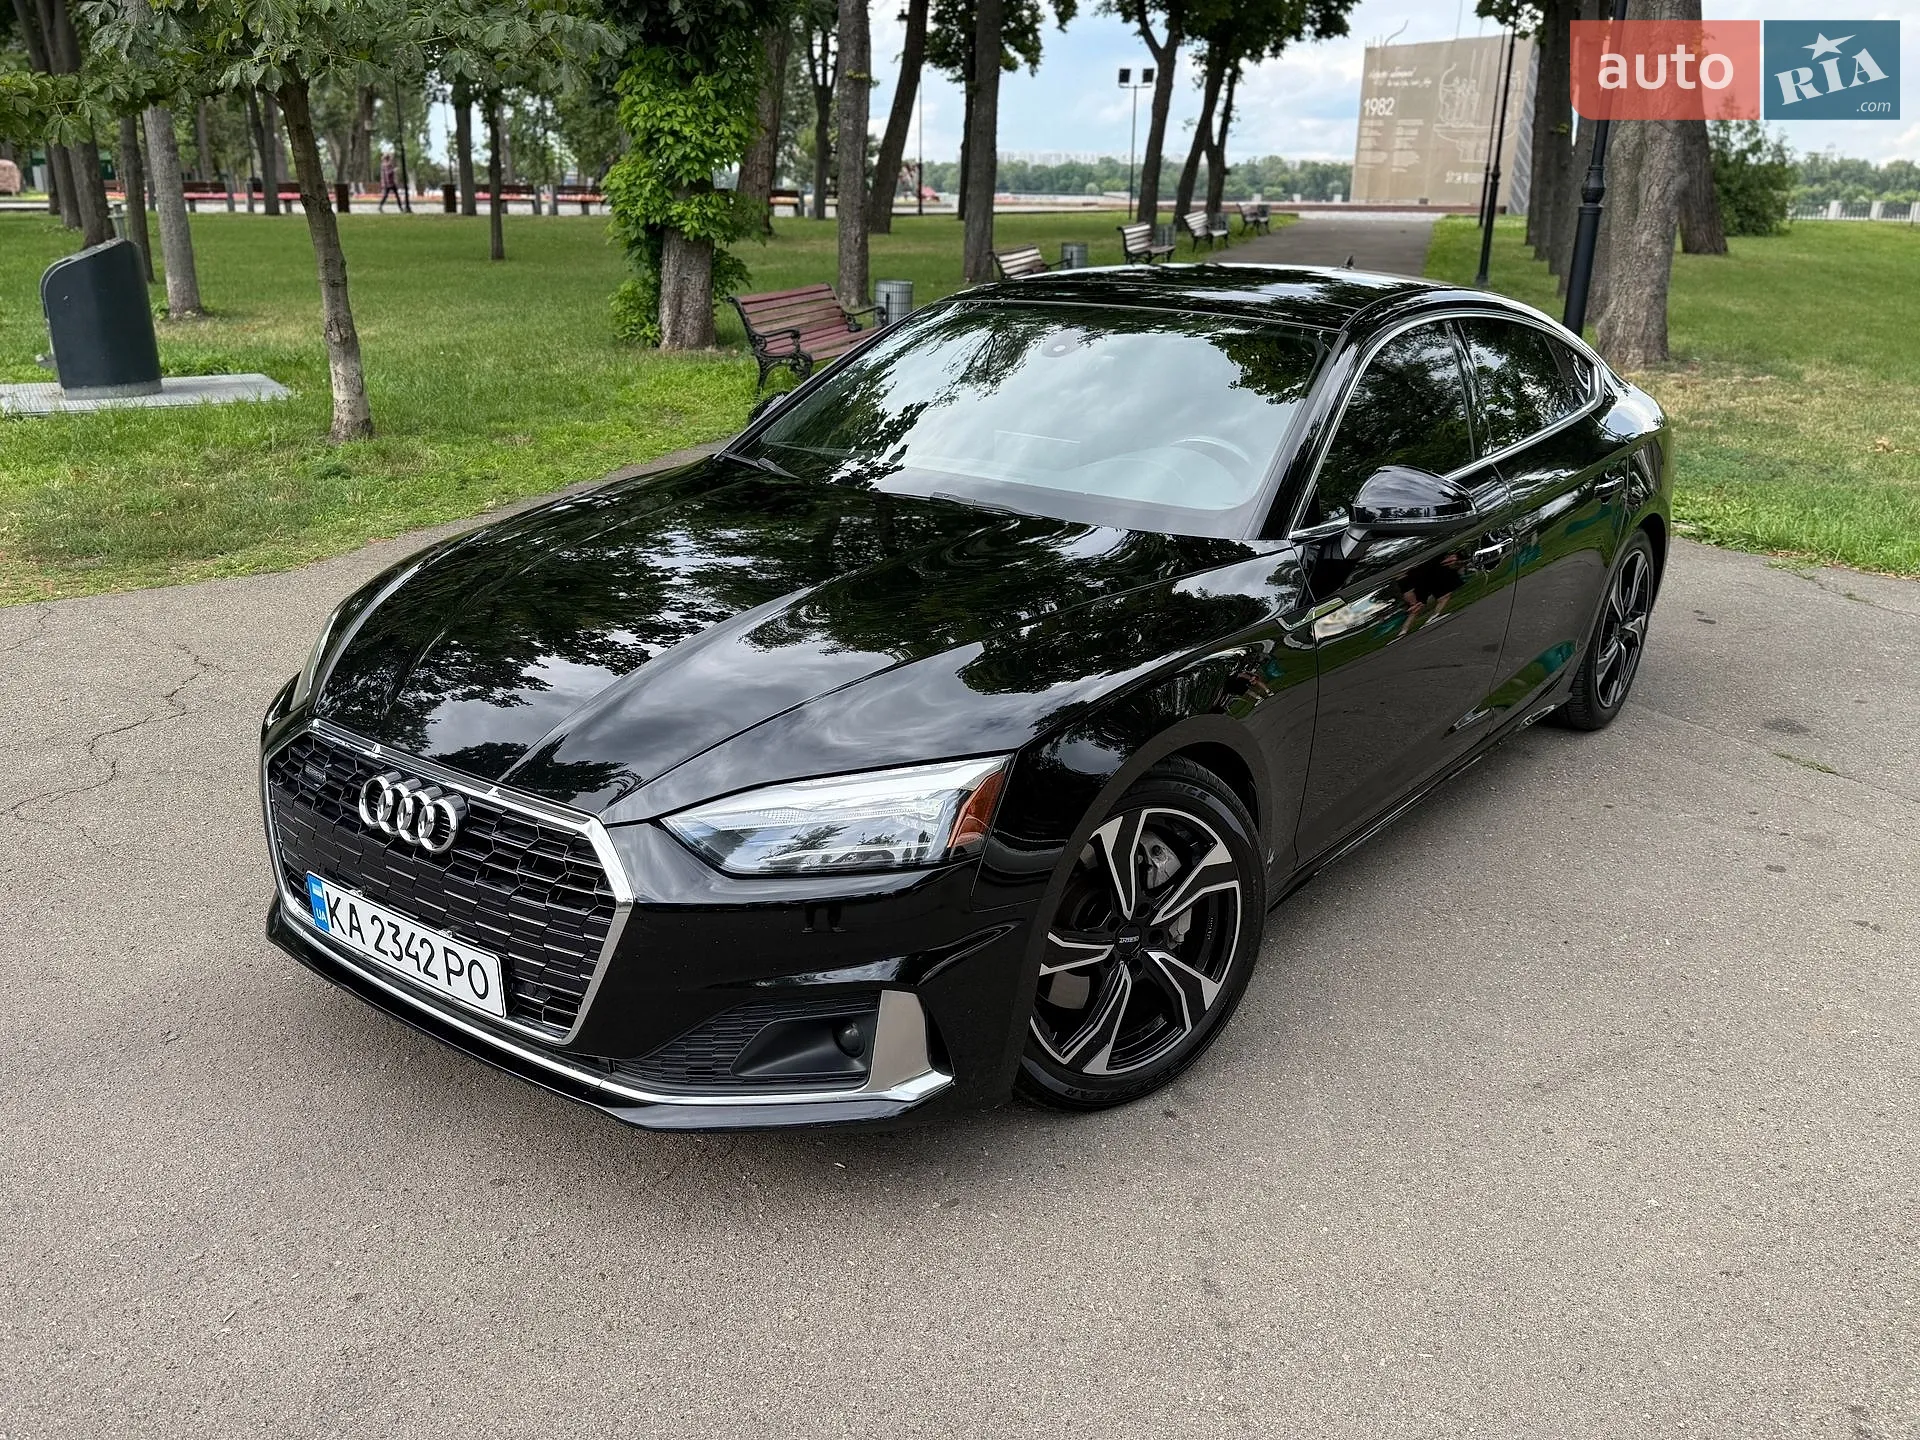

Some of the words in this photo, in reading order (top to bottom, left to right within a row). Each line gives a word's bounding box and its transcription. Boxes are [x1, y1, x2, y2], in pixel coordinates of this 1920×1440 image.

[1364, 97, 1395, 116] 1982
[316, 907, 327, 923] UA
[325, 891, 366, 945] KA
[371, 914, 438, 980] 2342
[443, 946, 489, 998] PO
